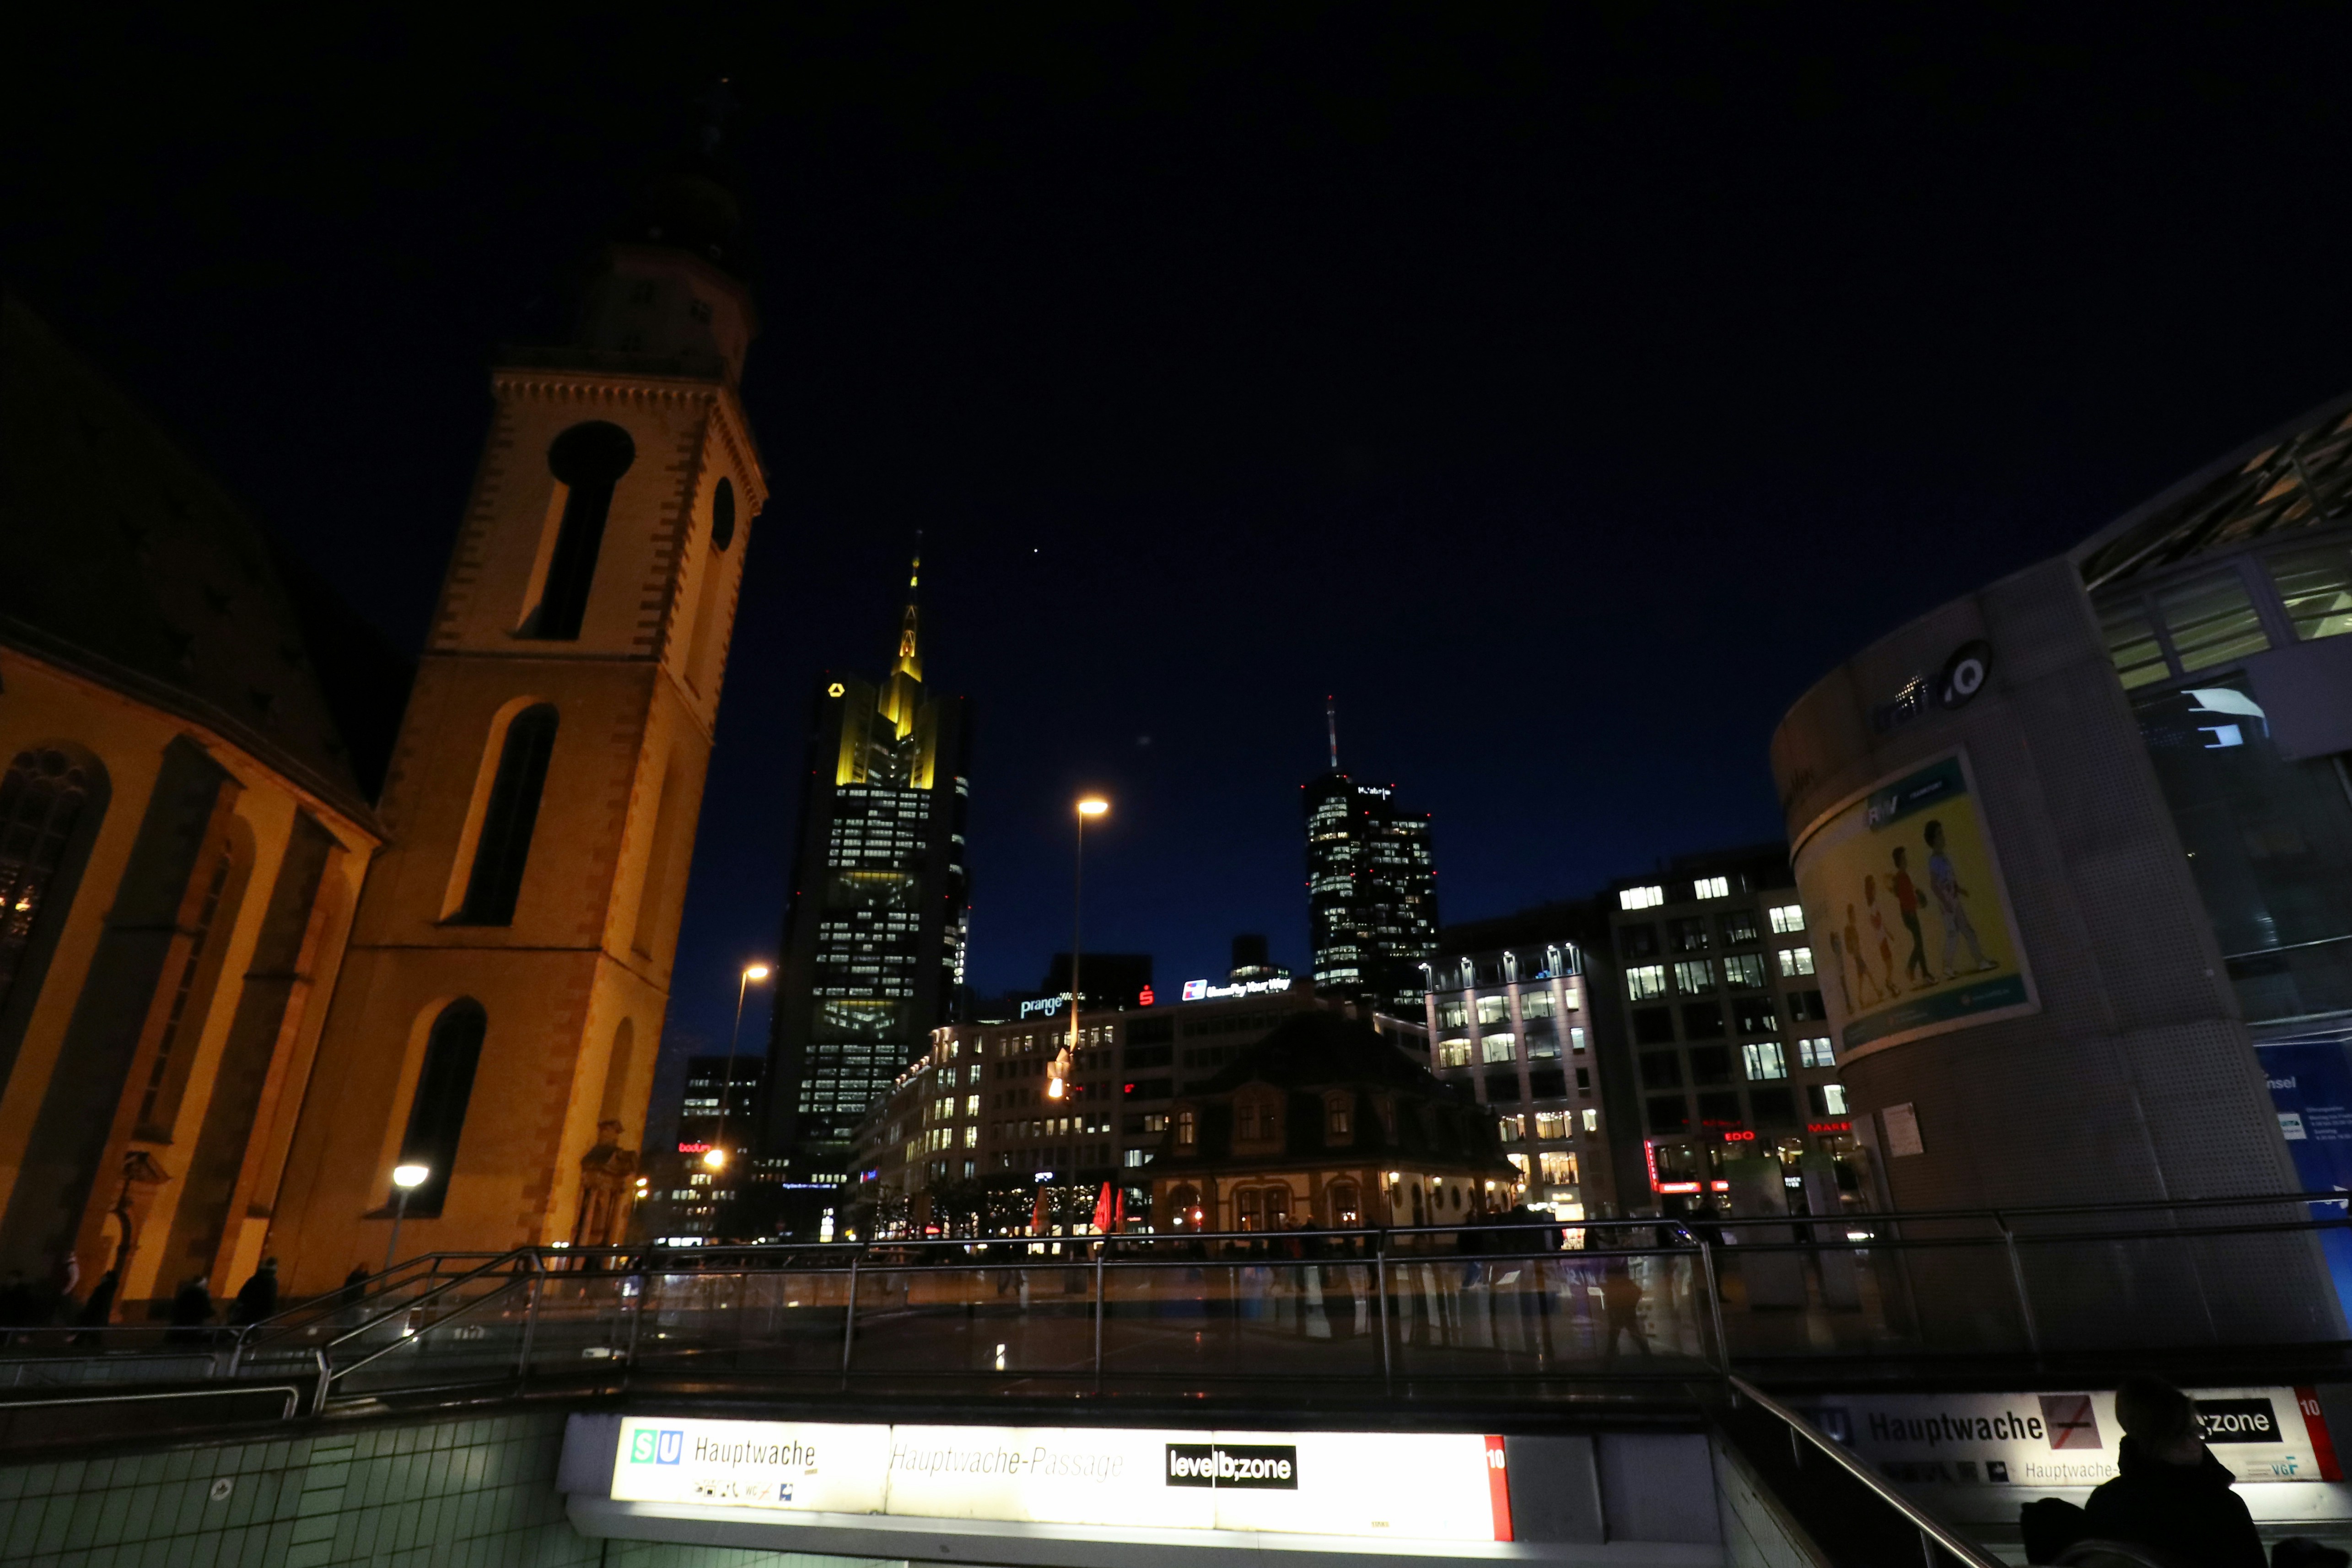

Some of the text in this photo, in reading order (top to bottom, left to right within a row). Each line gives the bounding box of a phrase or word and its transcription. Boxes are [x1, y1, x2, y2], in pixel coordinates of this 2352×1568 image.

[2266, 1076, 2296, 1089] nsel
[2300, 1400, 2320, 1416] 10
[1868, 1412, 2044, 1447] Hauptwache
[2196, 1413, 2270, 1436] ;zone
[635, 1432, 815, 1468] S U Hauptwache
[1486, 1449, 1506, 1469] 10
[890, 1444, 1123, 1483] Hauptwache-Passage
